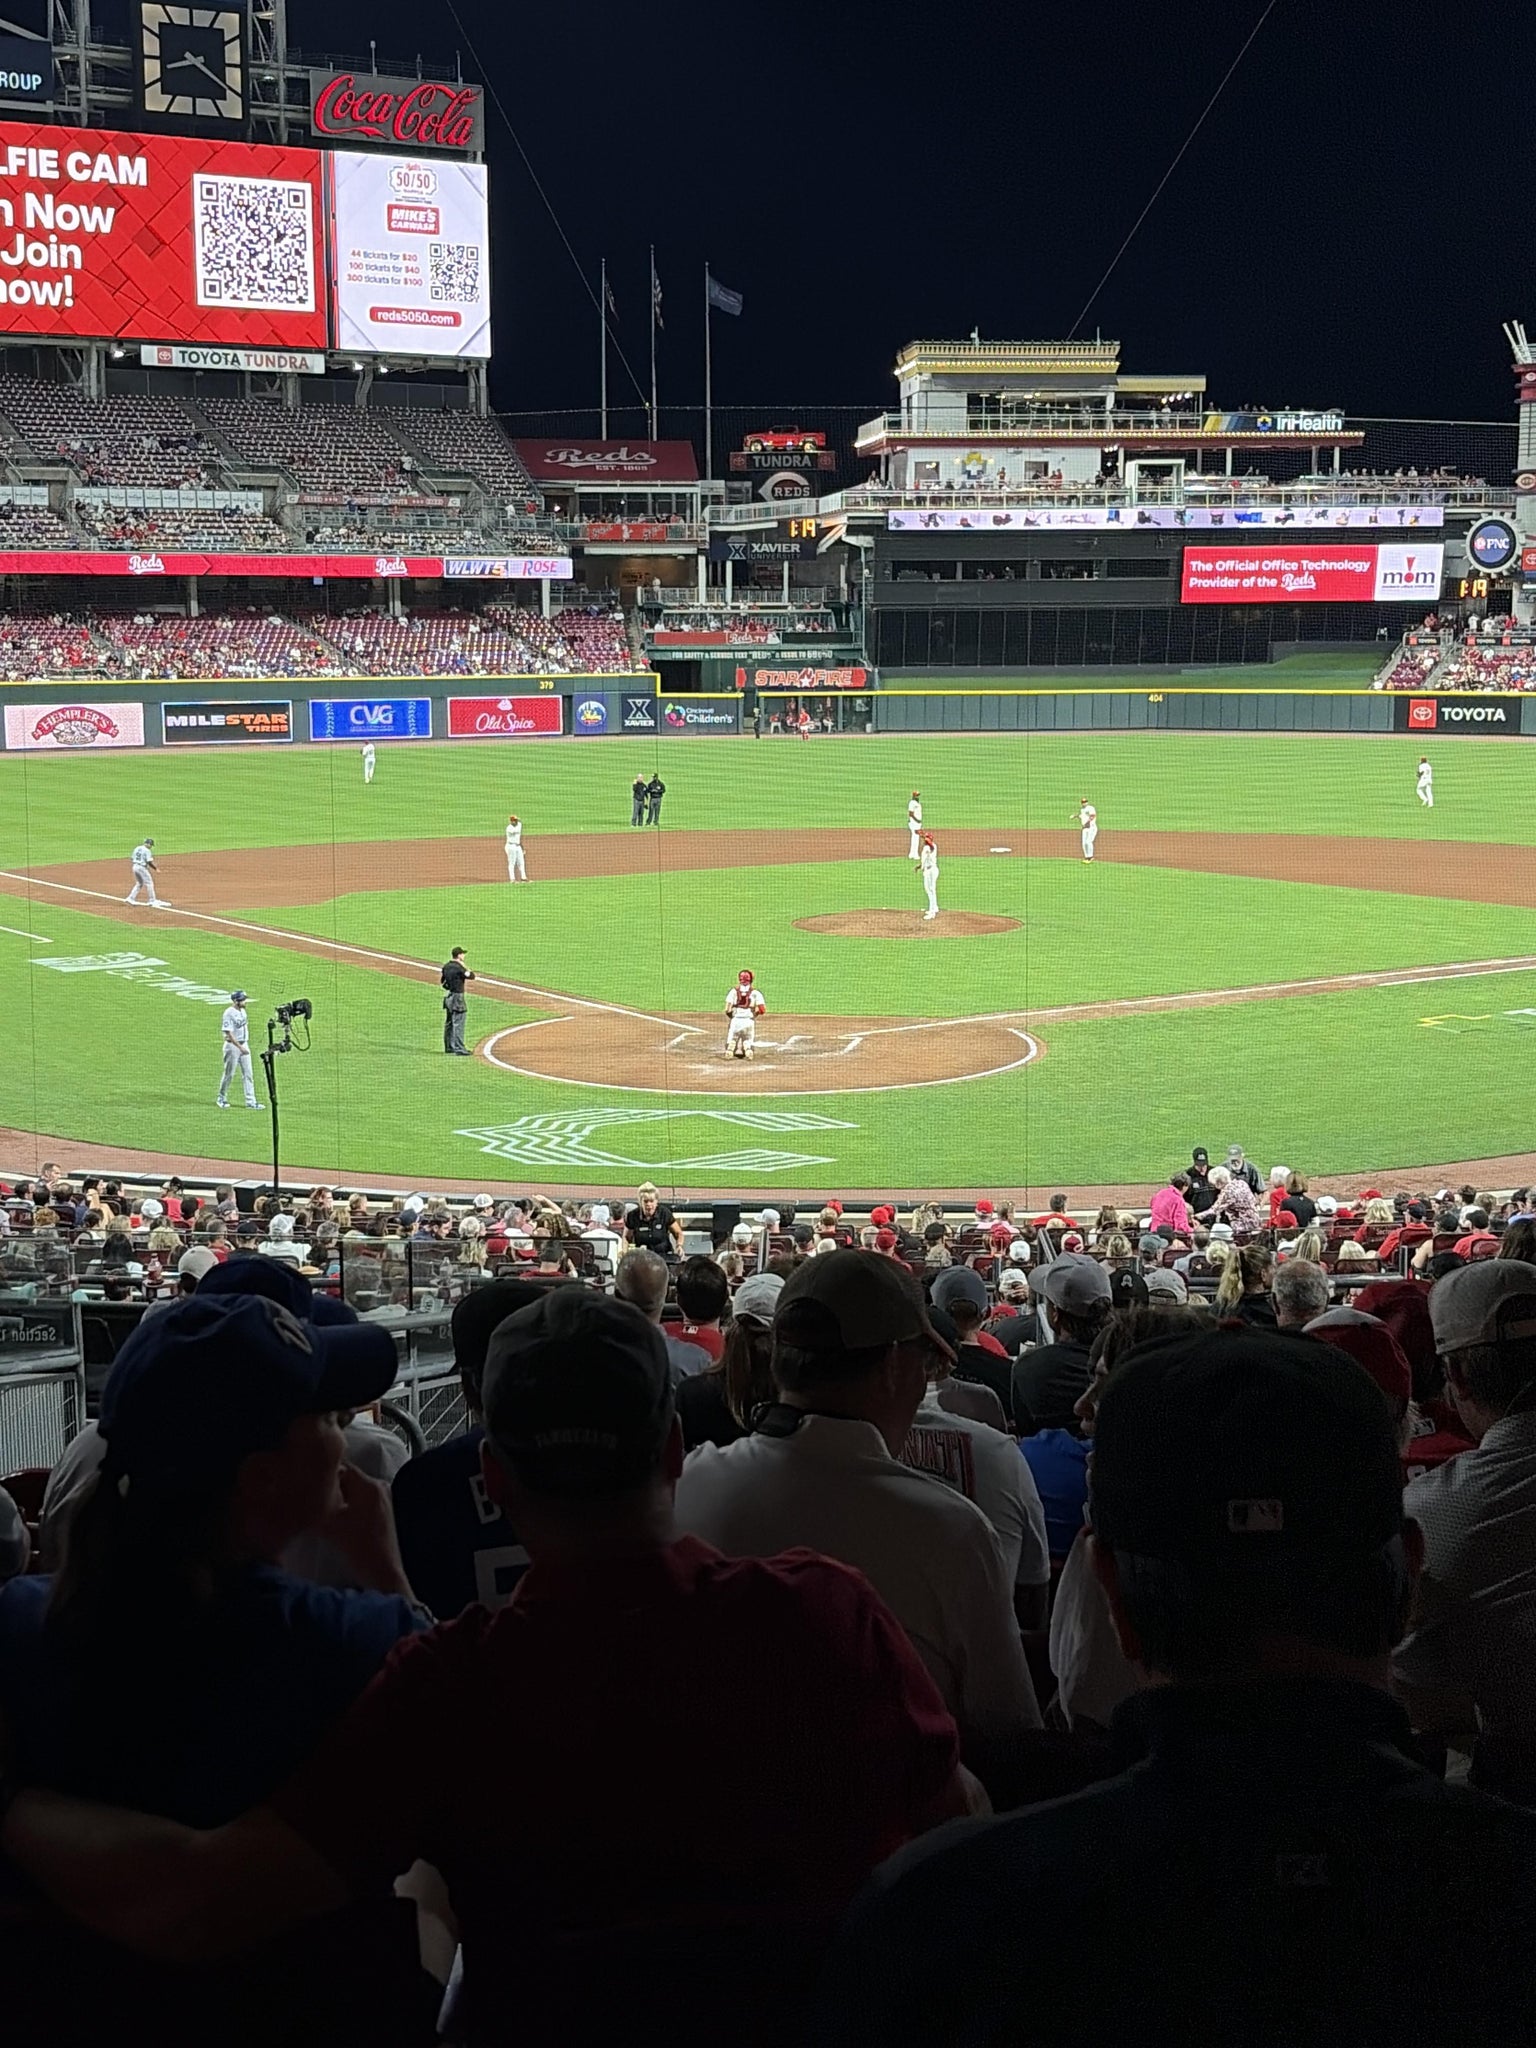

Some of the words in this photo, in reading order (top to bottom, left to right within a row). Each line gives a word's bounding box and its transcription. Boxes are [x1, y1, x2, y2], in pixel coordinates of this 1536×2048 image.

[66, 151, 148, 187] CAM
[396, 171, 430, 189] 50/50
[24, 192, 115, 234] Now
[391, 208, 437, 224] MIKE'S
[4, 233, 82, 270] Join
[363, 251, 388, 260] tickets
[402, 254, 417, 262] $20
[349, 262, 364, 270] 100
[365, 263, 390, 272] tickets
[392, 265, 402, 273] for
[404, 266, 420, 274] $40
[347, 274, 363, 282] 300
[364, 276, 389, 284] tickets
[391, 277, 401, 285] for
[403, 278, 423, 287] $100
[377, 310, 455, 326] reds5050.com
[179, 350, 241, 366] TOYOTA
[244, 353, 309, 370] TUNDRA
[1276, 414, 1343, 431] TriHealth
[543, 447, 658, 468] Reds
[753, 455, 812, 468] TUNDRA
[774, 486, 811, 497] REDS
[751, 543, 800, 553] XAVIER
[1486, 537, 1510, 550] PNC
[129, 554, 164, 574] Reds
[375, 558, 408, 576] Reds
[523, 560, 558, 576] ROSE
[1190, 560, 1213, 572] The
[1215, 560, 1259, 571] Official
[1261, 559, 1299, 571] Office
[1301, 559, 1371, 572] Technology
[1189, 576, 1240, 588] Provider
[1242, 576, 1255, 587] of
[1257, 576, 1278, 587] the
[1280, 572, 1316, 592] Reds
[755, 670, 800, 686] STAR
[813, 669, 853, 686] FIRE
[1148, 693, 1164, 702] 404
[41, 708, 110, 730] HEMPLER'S
[167, 713, 288, 726] MILESTAR
[350, 704, 396, 724] CVG
[686, 714, 734, 723] Children's
[1441, 707, 1506, 721] TOYOTA
[476, 713, 503, 729] Old
[501, 713, 535, 732] Spice
